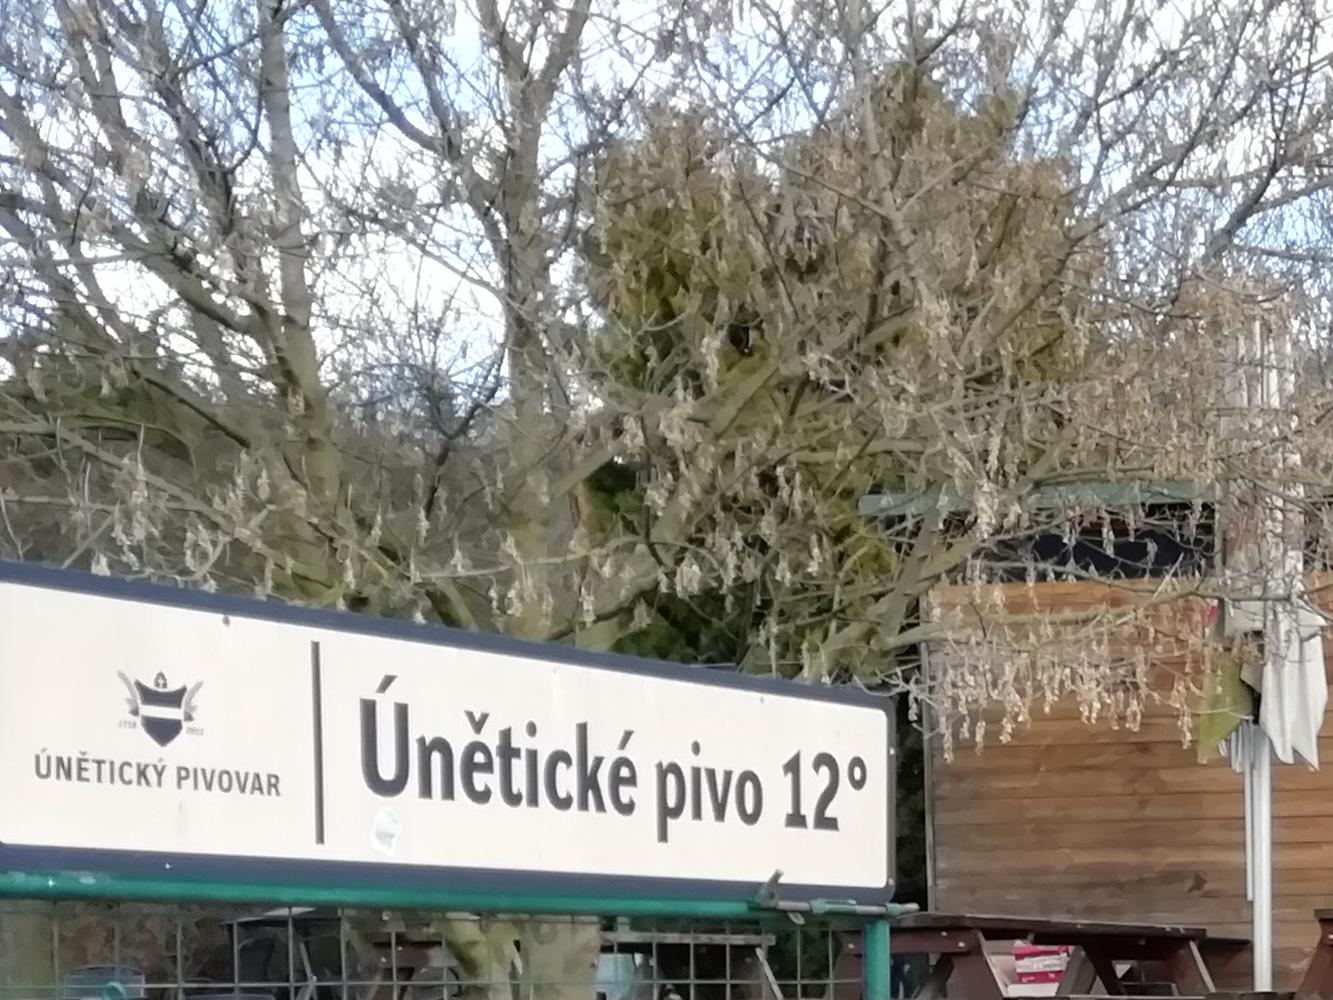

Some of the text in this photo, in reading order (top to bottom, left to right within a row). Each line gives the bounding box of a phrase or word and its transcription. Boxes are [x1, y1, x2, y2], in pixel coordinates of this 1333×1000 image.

[34, 748, 282, 797] ÚNĚTICKÝ PIVOVAR
[359, 674, 638, 817] Únětické
[655, 740, 764, 844] pivo
